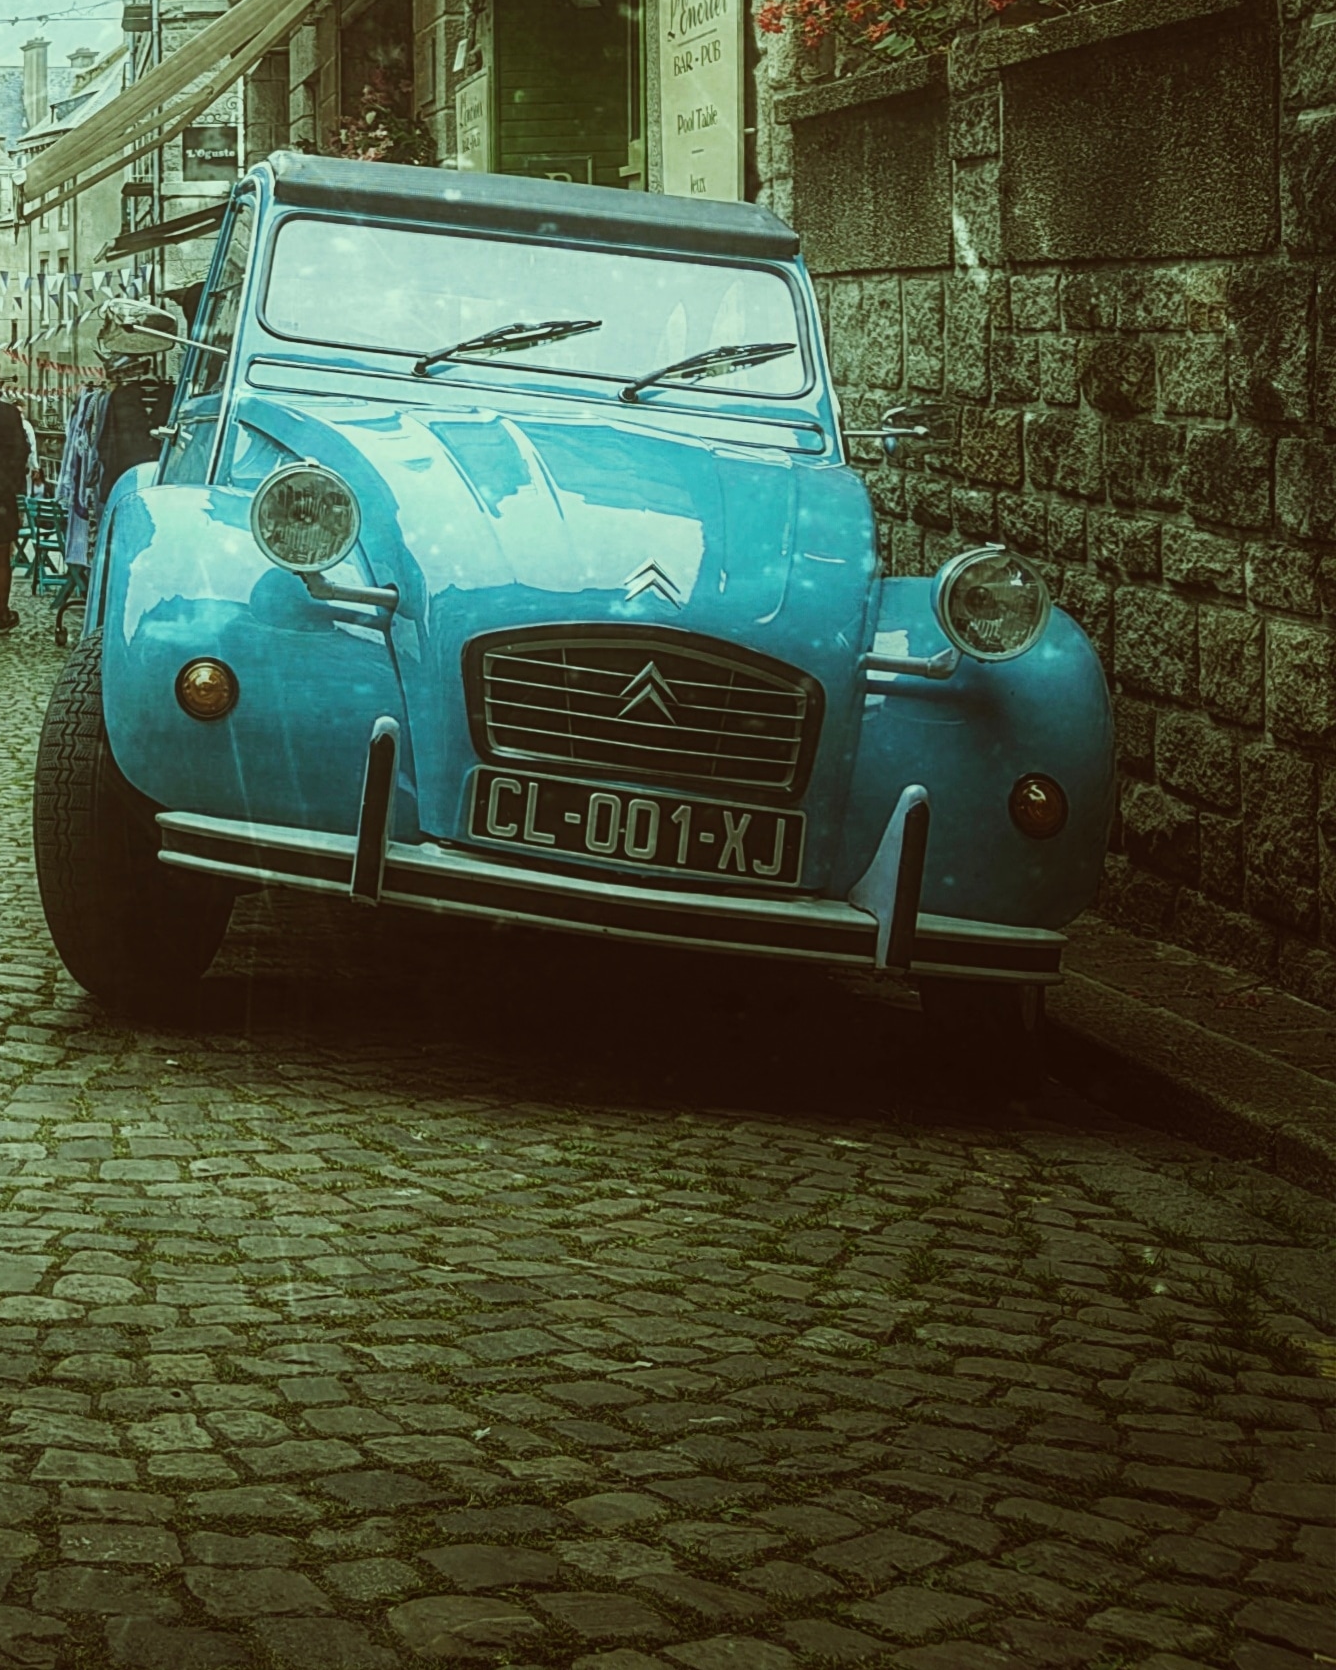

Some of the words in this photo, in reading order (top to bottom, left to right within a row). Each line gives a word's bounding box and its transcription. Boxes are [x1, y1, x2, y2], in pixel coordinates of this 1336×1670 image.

[678, 114, 694, 135] Pool
[696, 105, 717, 129] Table
[487, 778, 785, 875] CL-001-XJ
